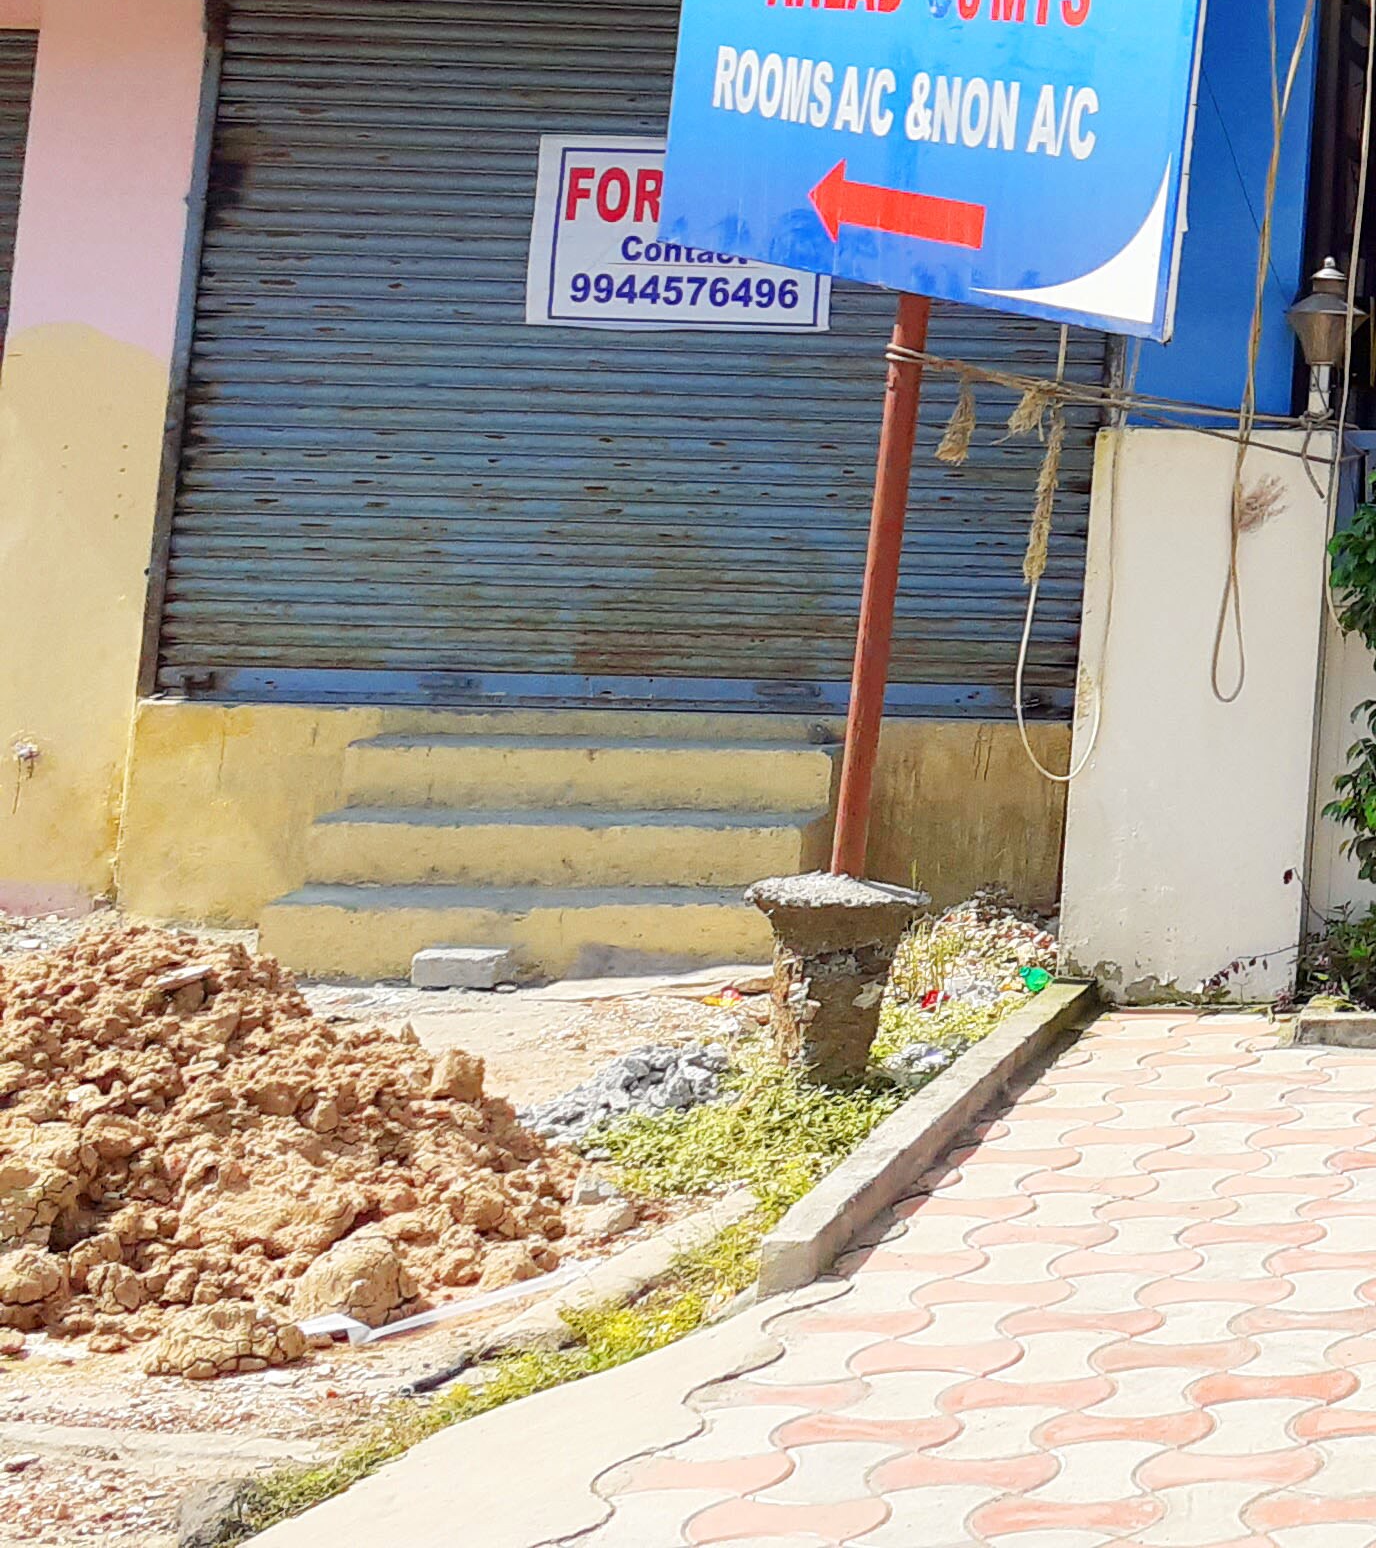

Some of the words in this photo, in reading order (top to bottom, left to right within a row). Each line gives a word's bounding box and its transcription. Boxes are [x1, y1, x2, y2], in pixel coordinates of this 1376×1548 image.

[712, 45, 835, 128] ROOMS
[833, 66, 897, 137] A/C
[1025, 84, 1100, 161] A/C
[565, 167, 663, 223] FOR
[621, 235, 749, 264] Conta
[569, 272, 799, 310] 9944576496
